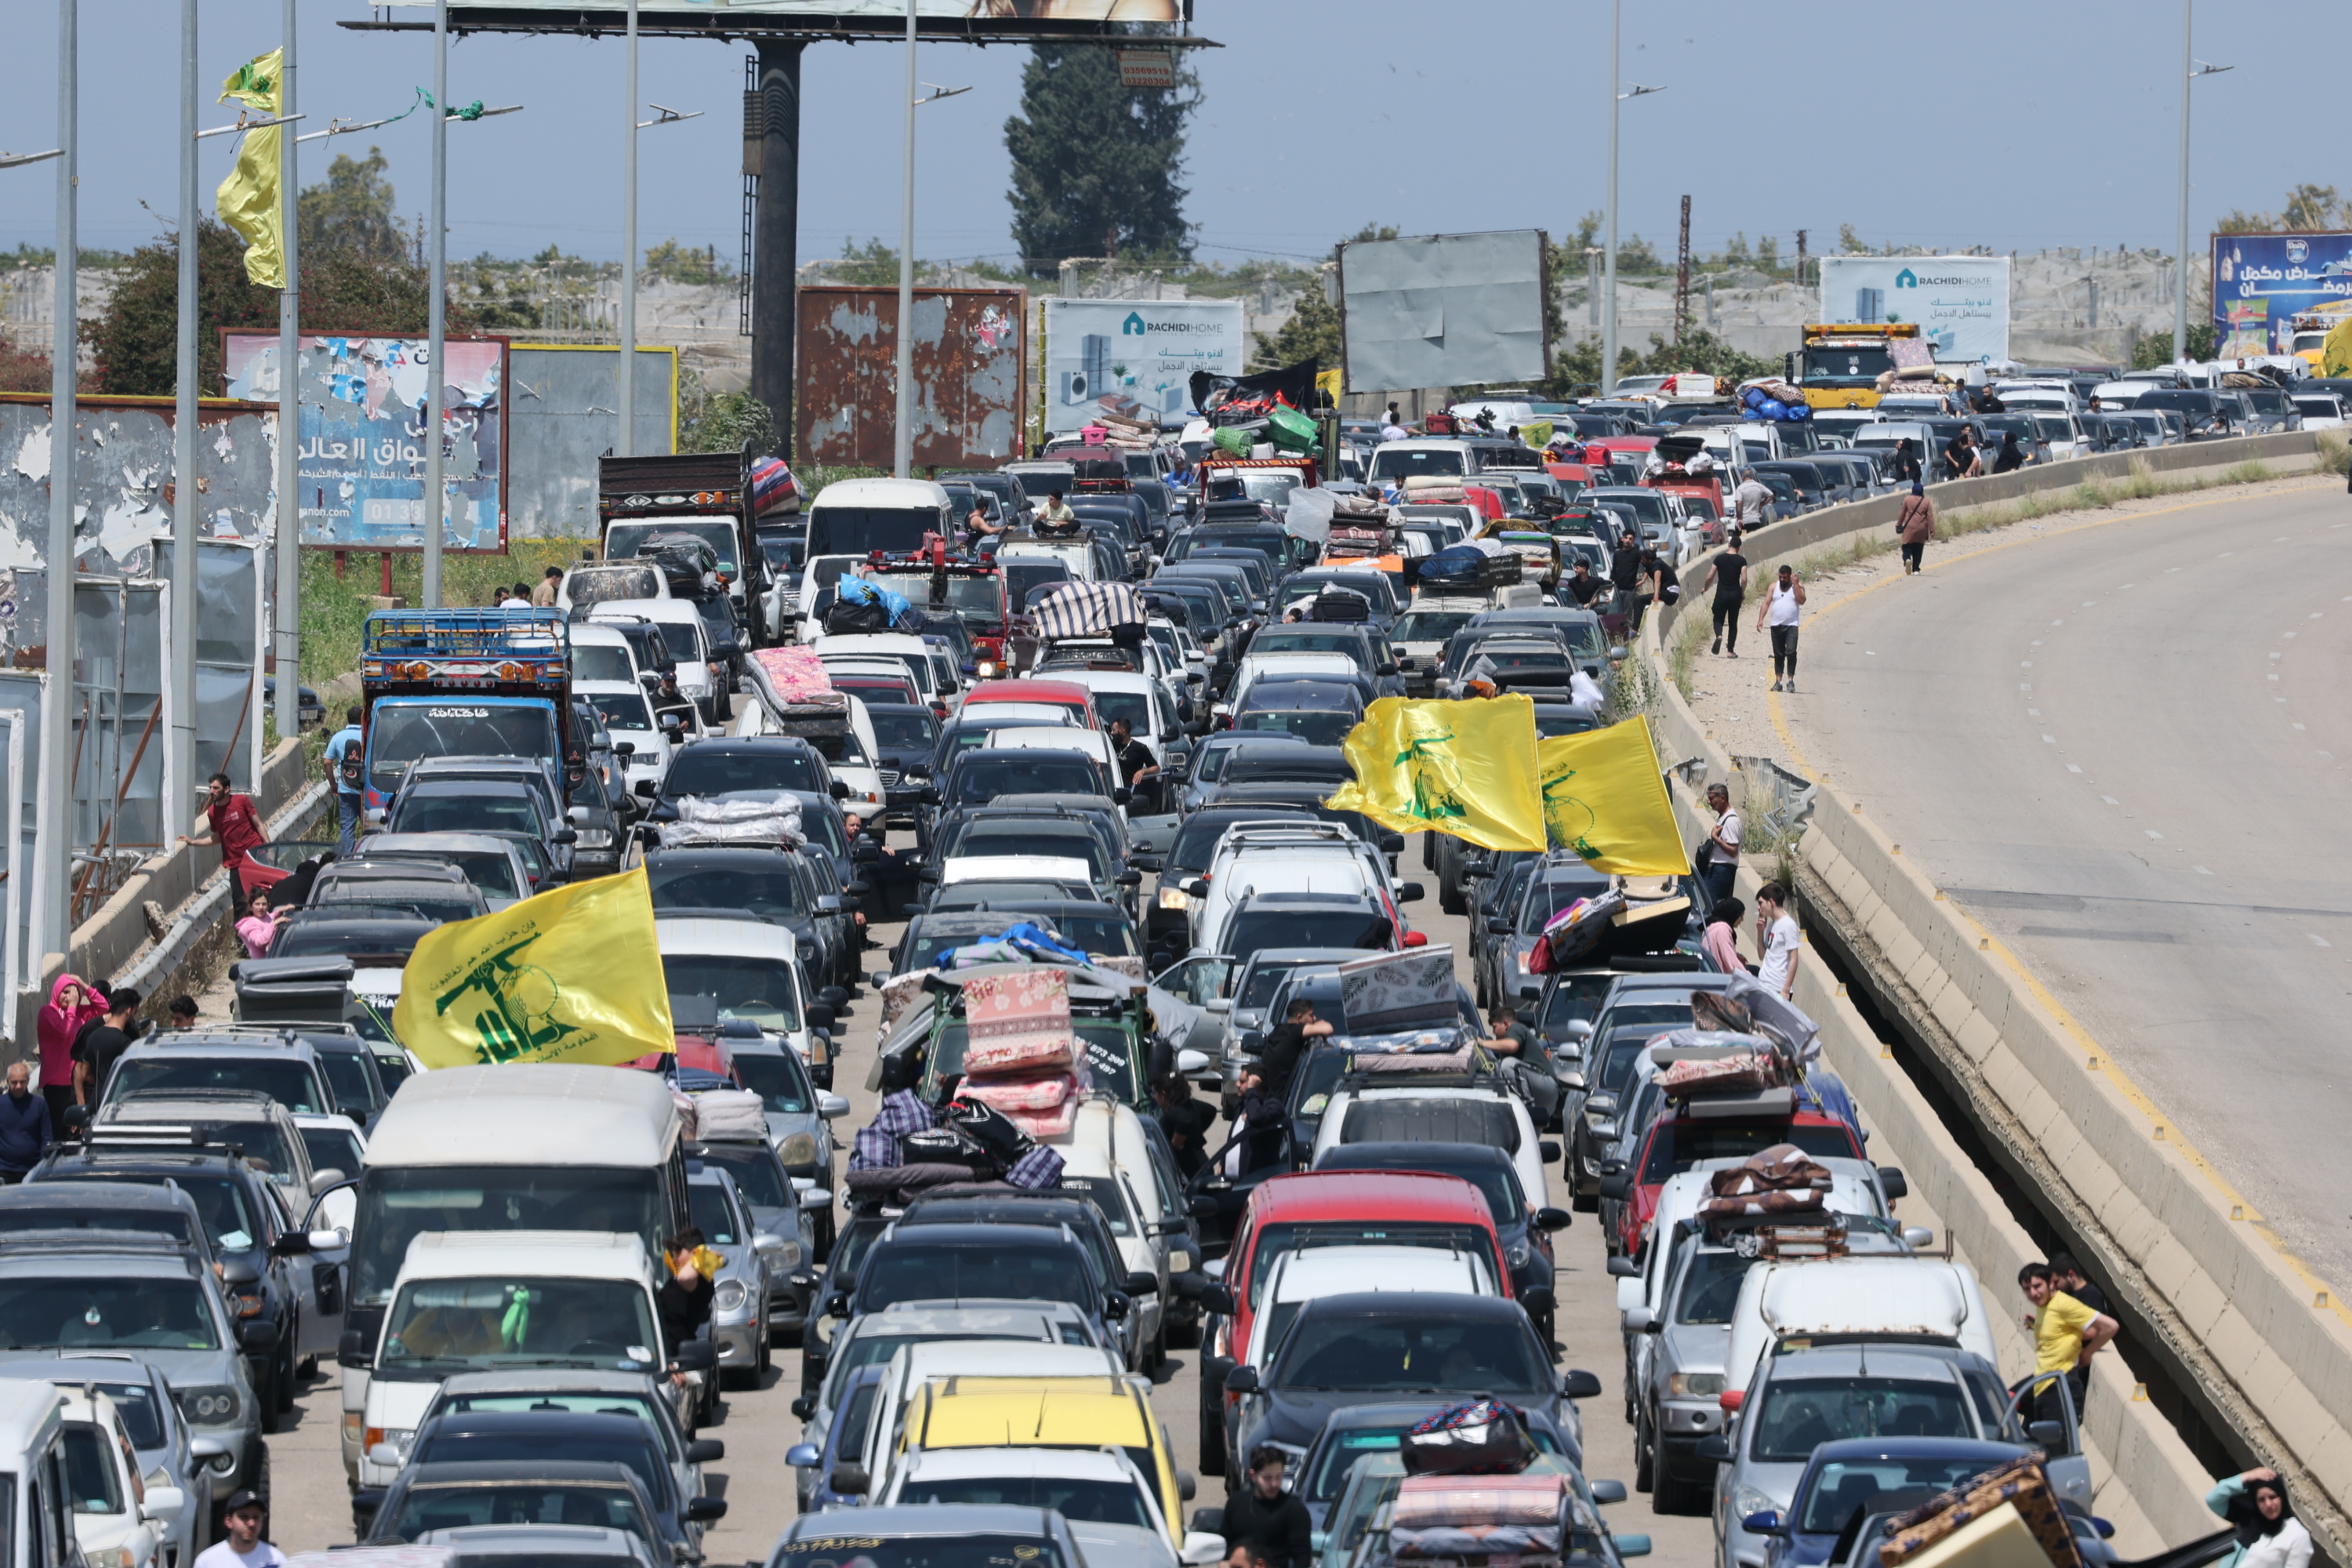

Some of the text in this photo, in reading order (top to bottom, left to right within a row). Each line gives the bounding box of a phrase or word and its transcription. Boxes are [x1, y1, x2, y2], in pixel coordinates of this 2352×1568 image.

[2240, 266, 2282, 281] مكمل
[370, 470, 395, 479] النفط
[372, 504, 391, 520] 01
[495, 931, 518, 945] حزب
[481, 943, 493, 955] الله
[430, 965, 464, 990] الغالبون
